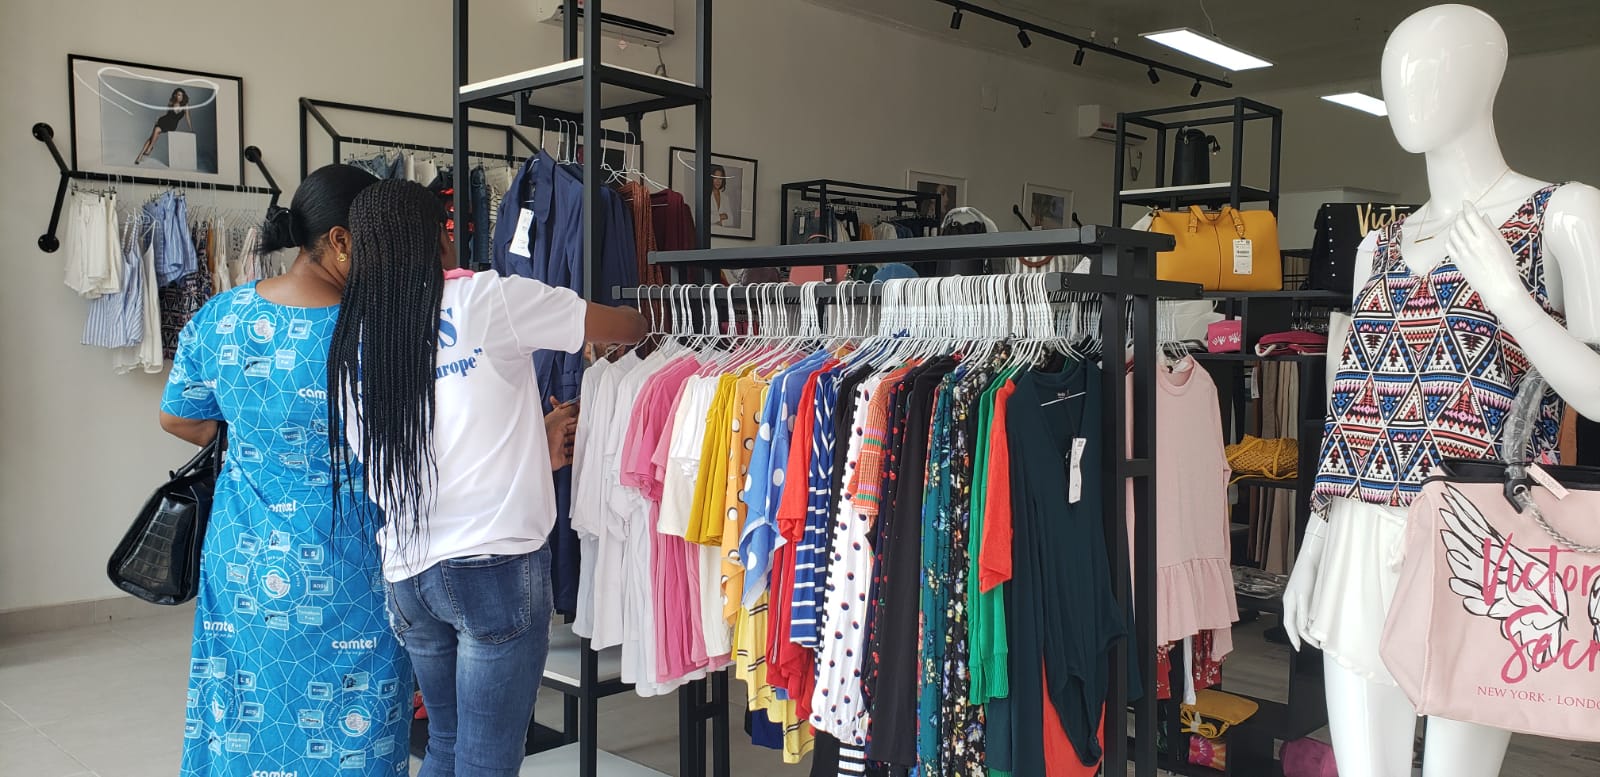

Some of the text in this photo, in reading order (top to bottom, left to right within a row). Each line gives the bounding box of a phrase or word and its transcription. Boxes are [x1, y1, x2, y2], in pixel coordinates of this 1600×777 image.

[331, 636, 377, 649] camtel
[1477, 686, 1507, 698] NEW
[1510, 689, 1545, 703] YORK
